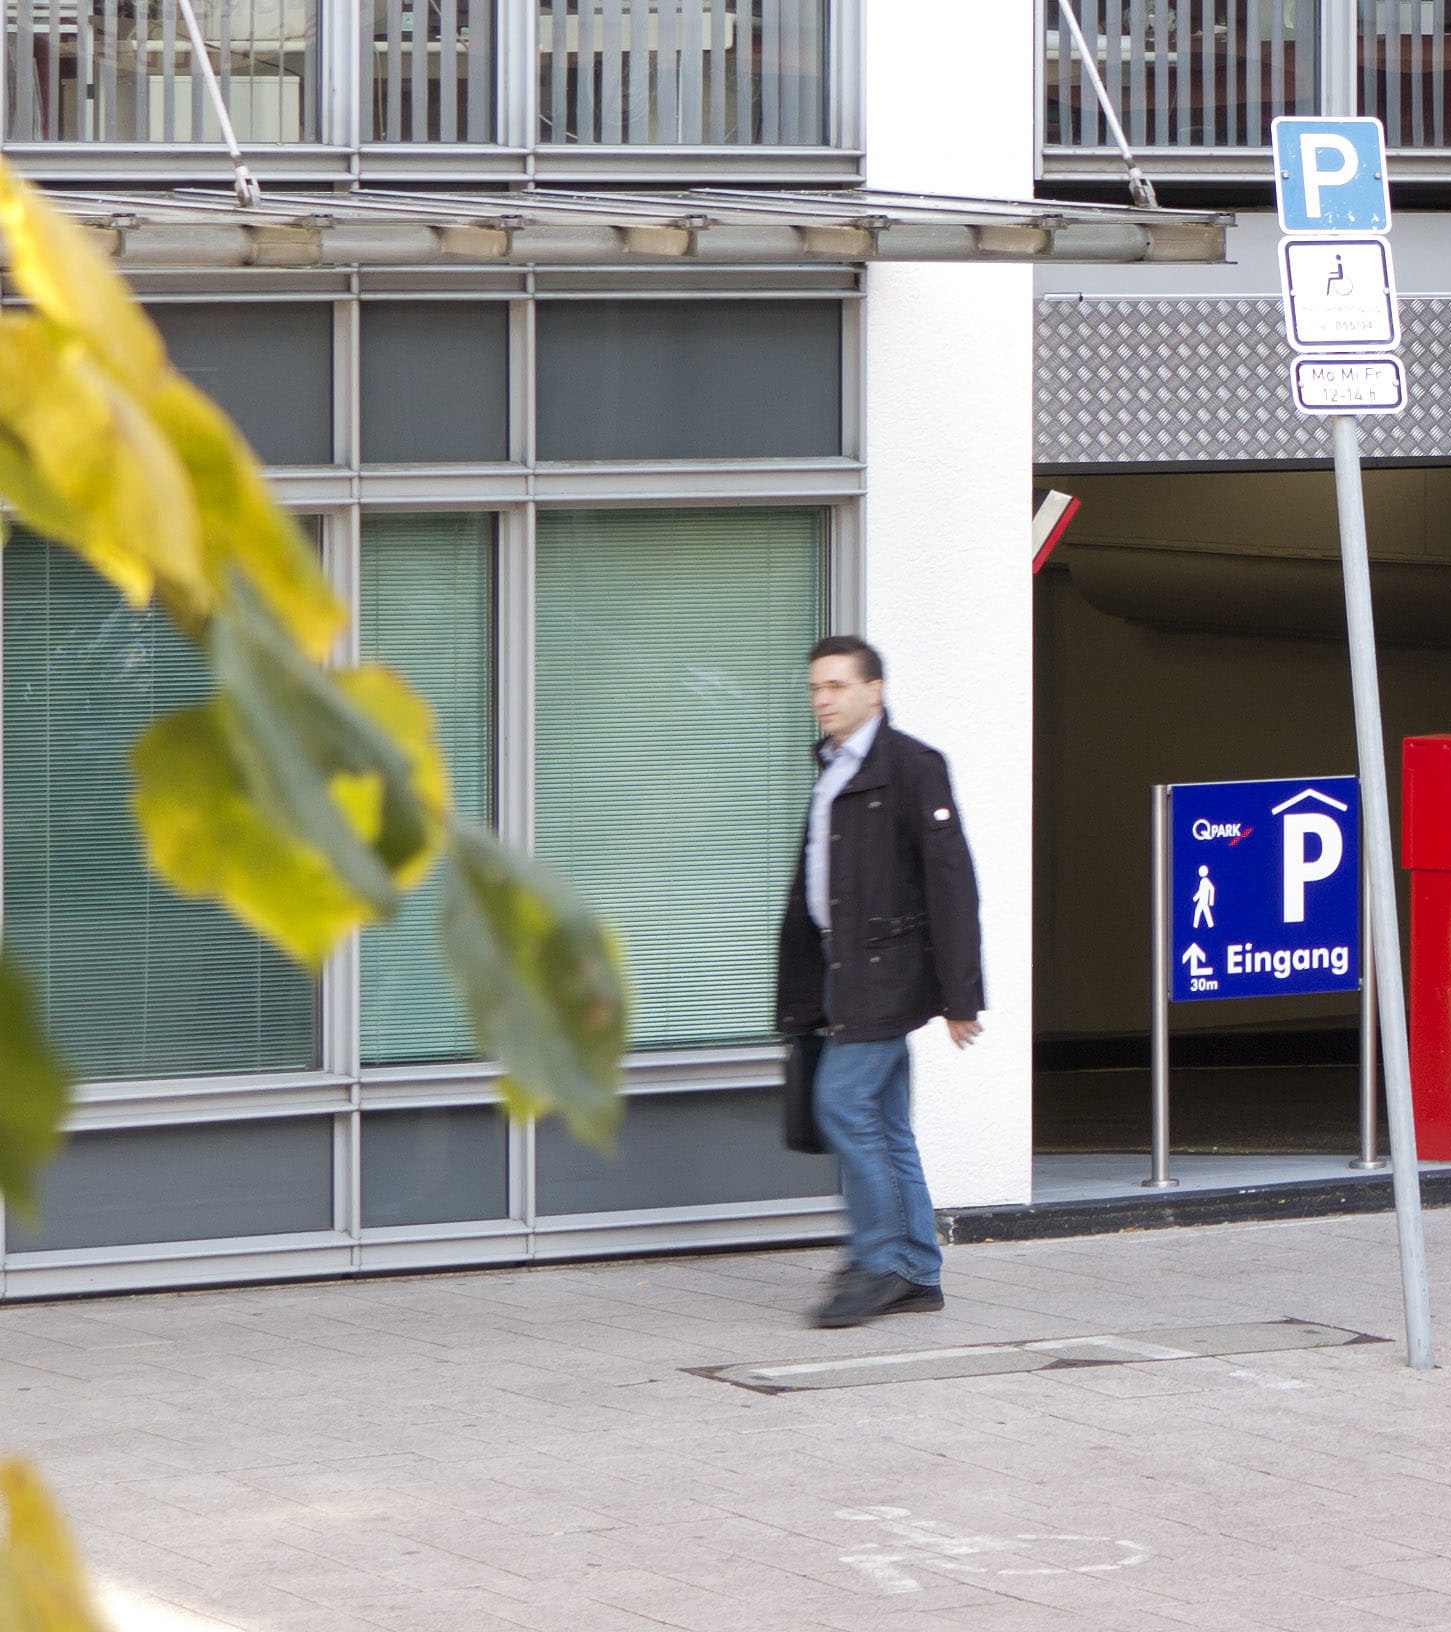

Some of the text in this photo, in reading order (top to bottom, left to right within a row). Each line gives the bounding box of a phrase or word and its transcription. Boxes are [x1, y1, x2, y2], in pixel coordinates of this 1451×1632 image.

[1299, 133, 1359, 218] P
[1312, 367, 1335, 382] Mo
[1365, 367, 1382, 381] Fr
[1323, 387, 1363, 402] 12-14
[1283, 812, 1343, 924] P
[1227, 943, 1349, 979] Eingang
[1190, 978, 1218, 992] 30m
